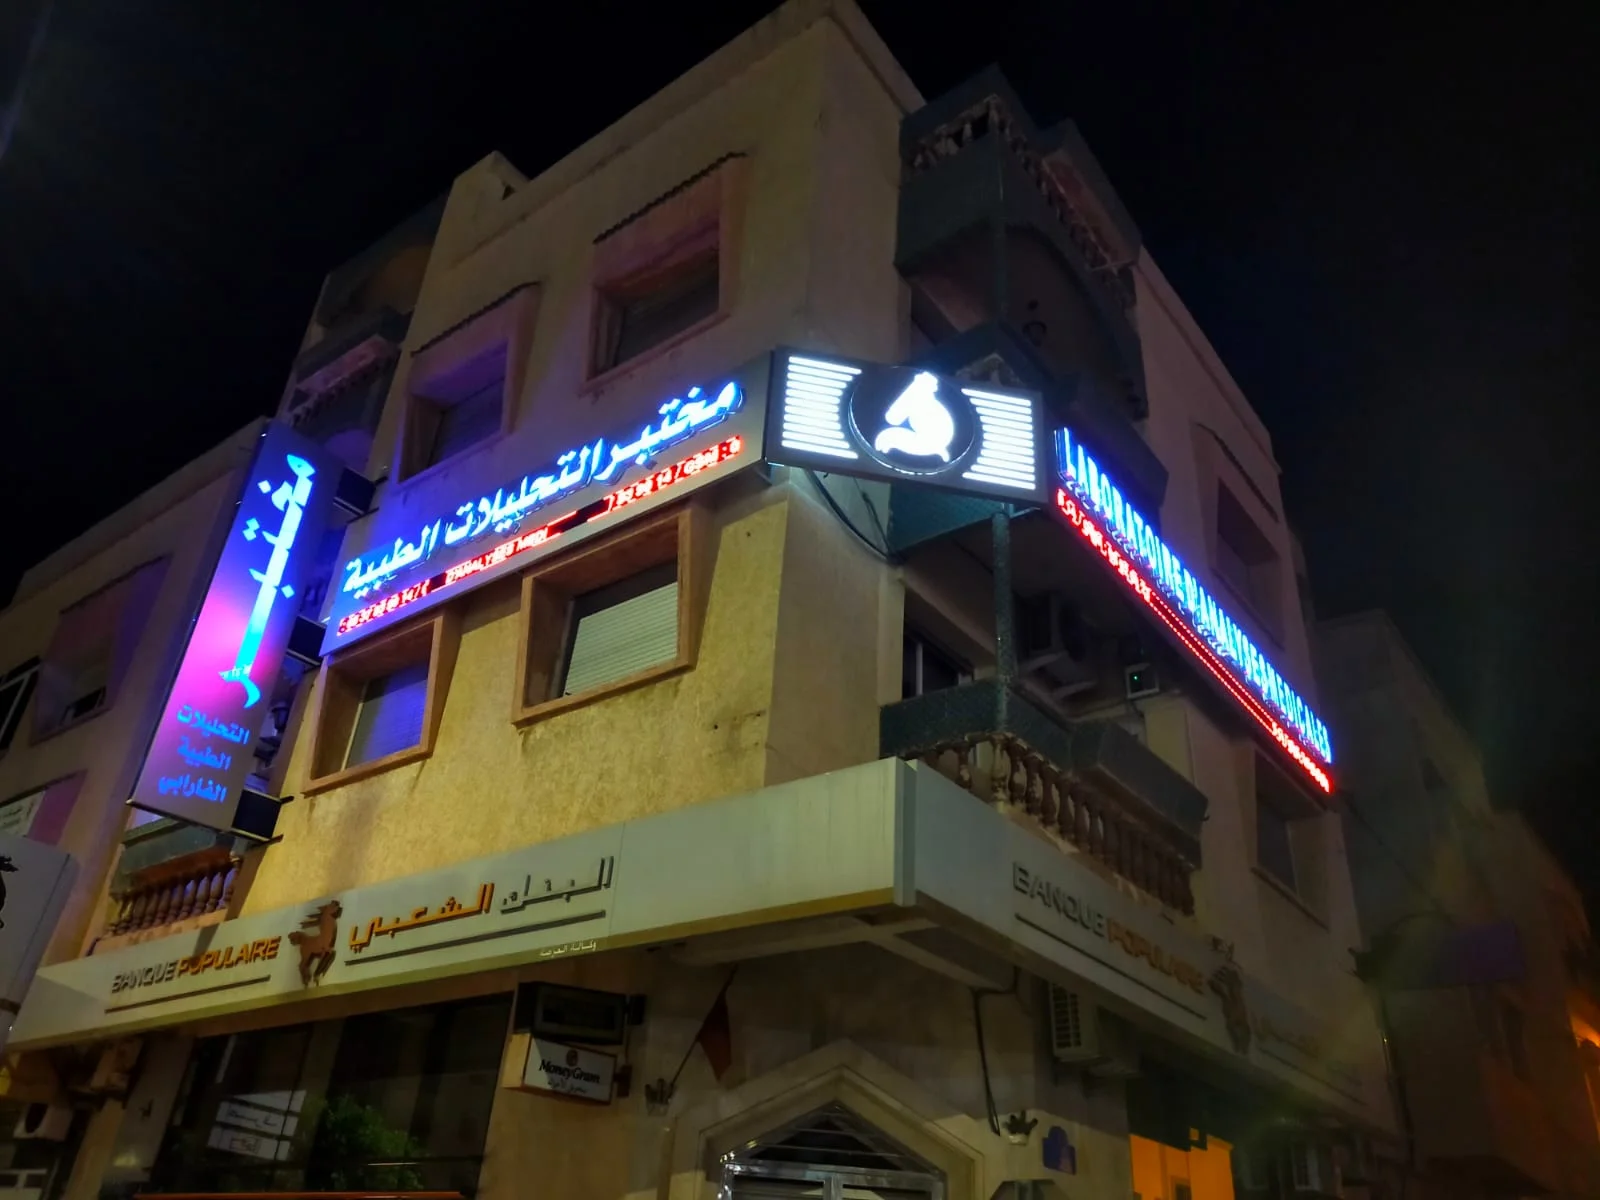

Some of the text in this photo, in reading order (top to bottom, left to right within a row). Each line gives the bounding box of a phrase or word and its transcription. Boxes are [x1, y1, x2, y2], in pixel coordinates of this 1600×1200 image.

[342, 381, 742, 599] مختبر التحليلات الطبية
[1062, 427, 1186, 601] LABORATOIRE
[176, 704, 250, 745] التحليلات
[177, 735, 232, 771] الطبية
[157, 770, 227, 804] الفارابي
[348, 855, 616, 954] البنك الشعبي
[1012, 860, 1107, 938] BANQUE
[110, 935, 283, 993] BANQUE POPULAIRE
[538, 1057, 601, 1086] MoneyGram
